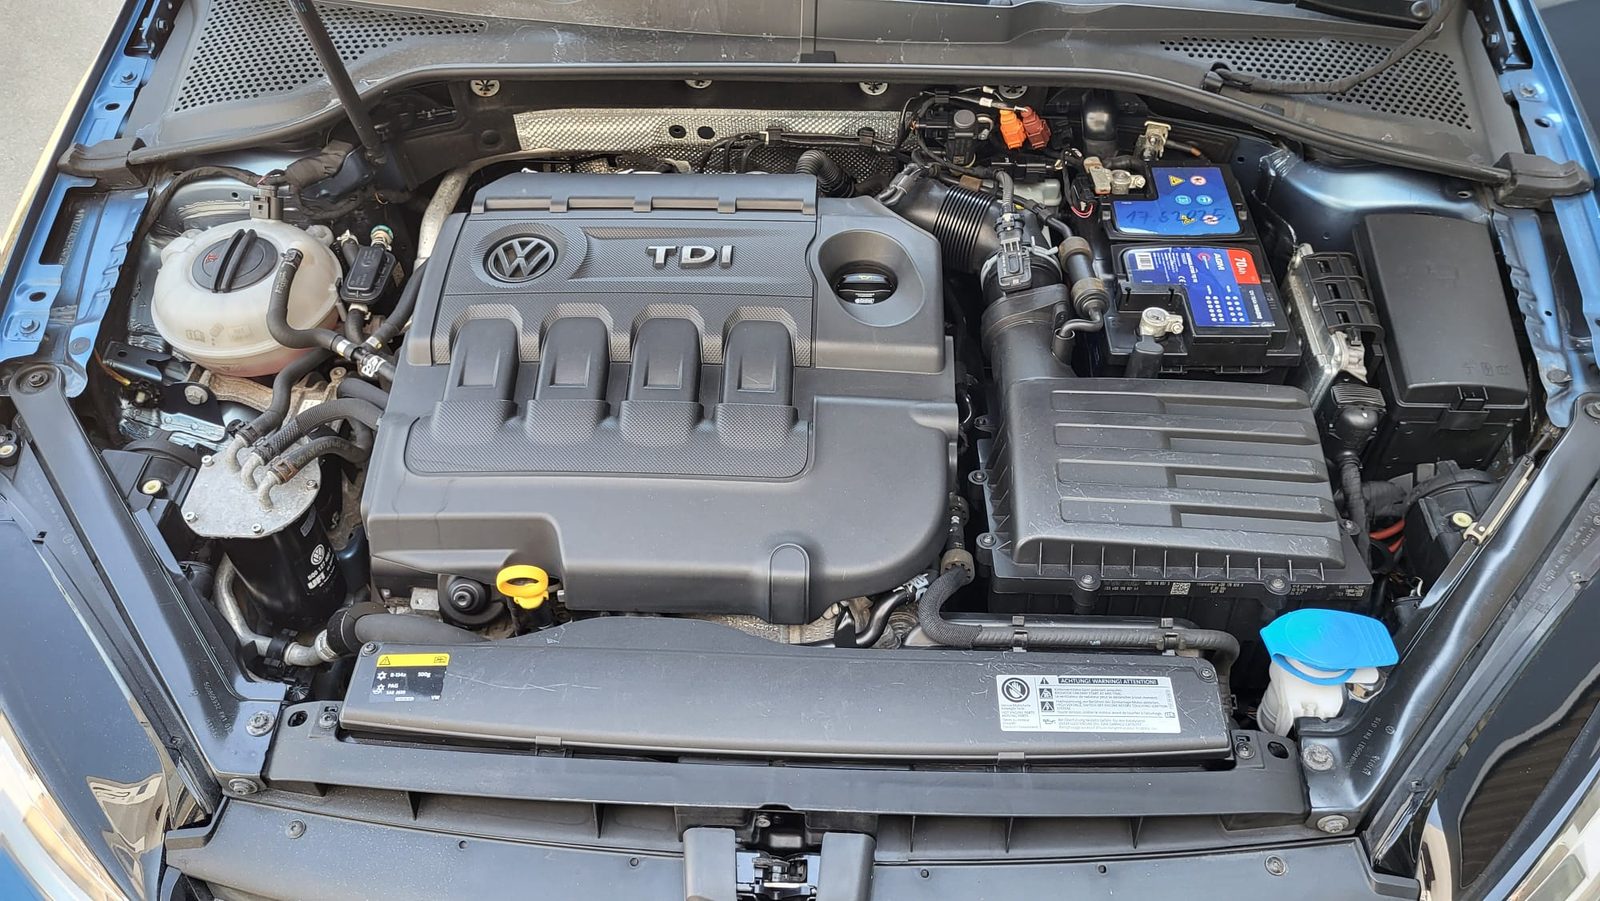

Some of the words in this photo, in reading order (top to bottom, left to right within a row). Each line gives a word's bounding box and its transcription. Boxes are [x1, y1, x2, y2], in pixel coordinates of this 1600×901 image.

[646, 244, 734, 269] TDI
[1214, 253, 1225, 271] AGM
[1234, 257, 1247, 275] 70Ah
